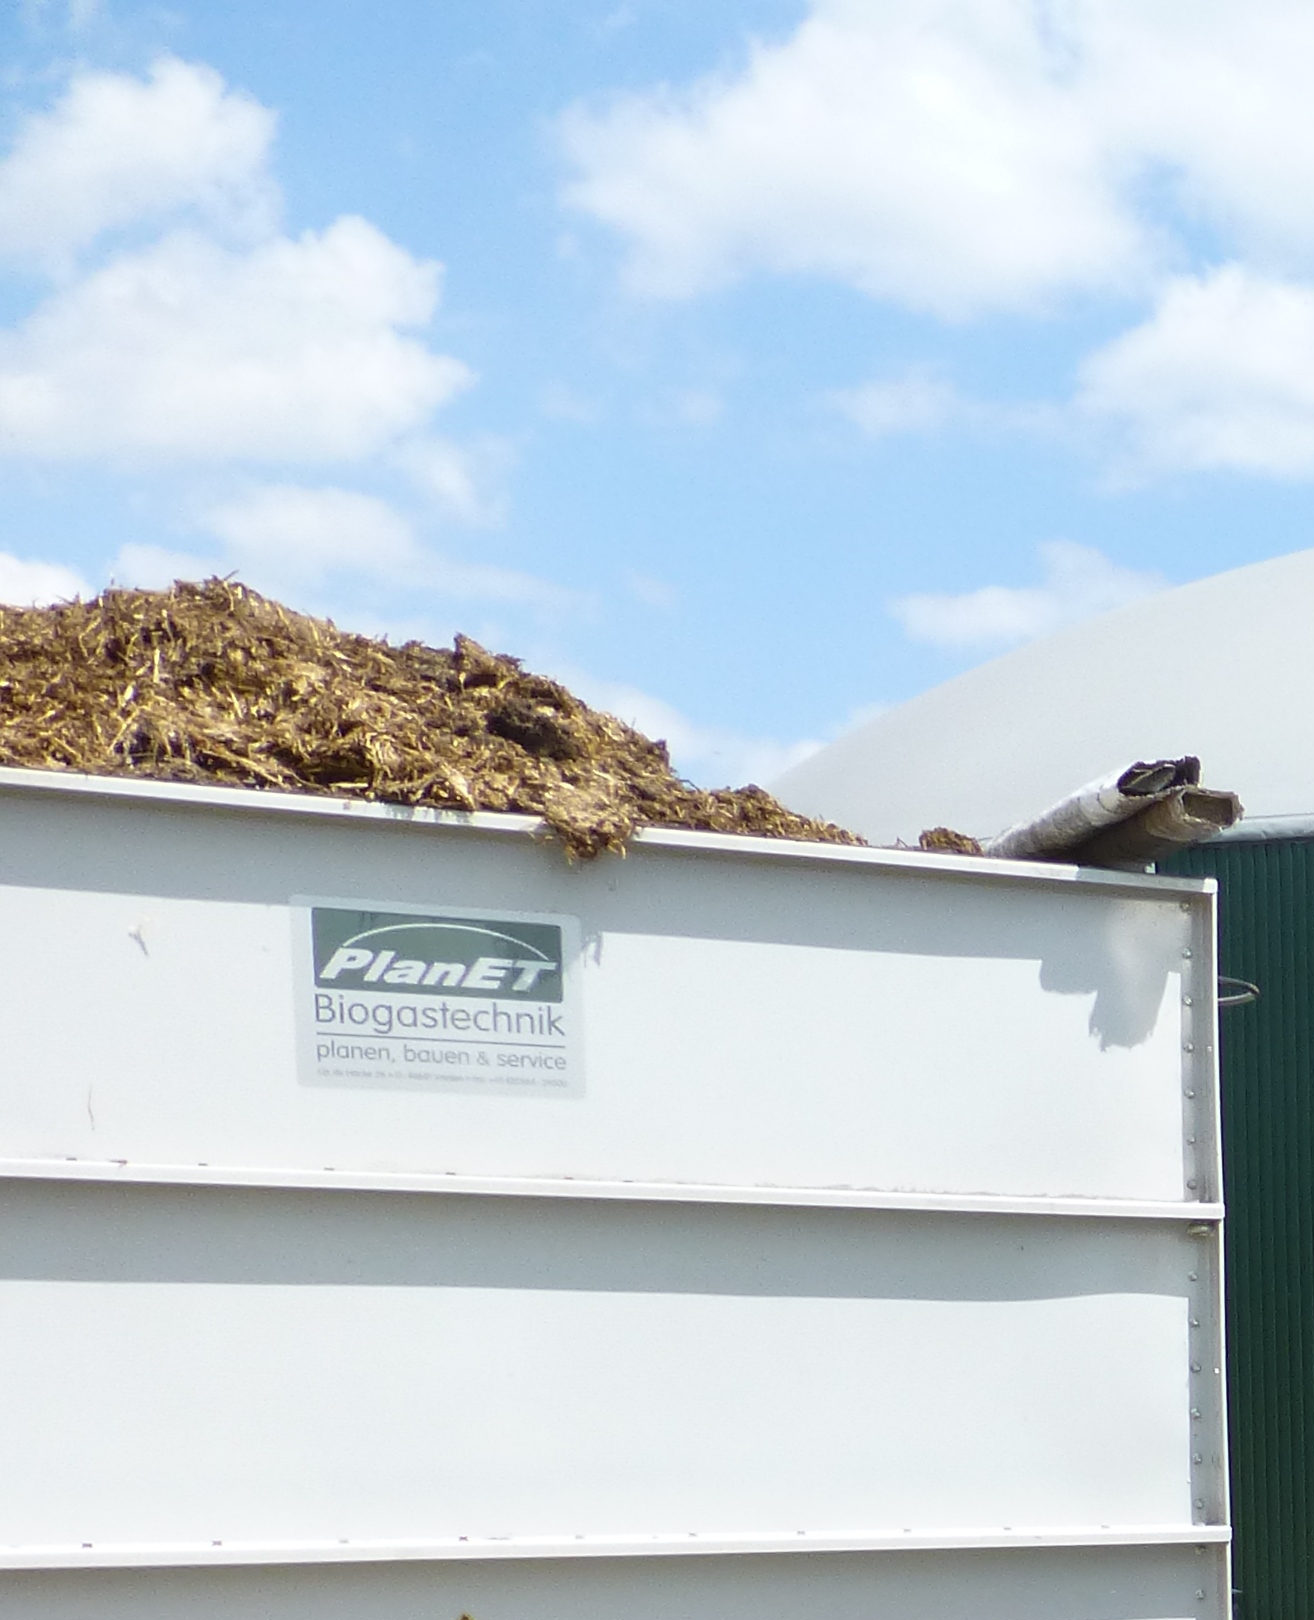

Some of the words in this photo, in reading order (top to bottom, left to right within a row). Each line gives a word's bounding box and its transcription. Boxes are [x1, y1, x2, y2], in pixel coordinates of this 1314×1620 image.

[319, 945, 558, 994] PlanET
[314, 993, 566, 1037] Biogastechnik
[316, 1038, 396, 1064] planen,
[403, 1044, 469, 1065] bauen
[476, 1051, 490, 1067] &
[497, 1050, 567, 1071] service
